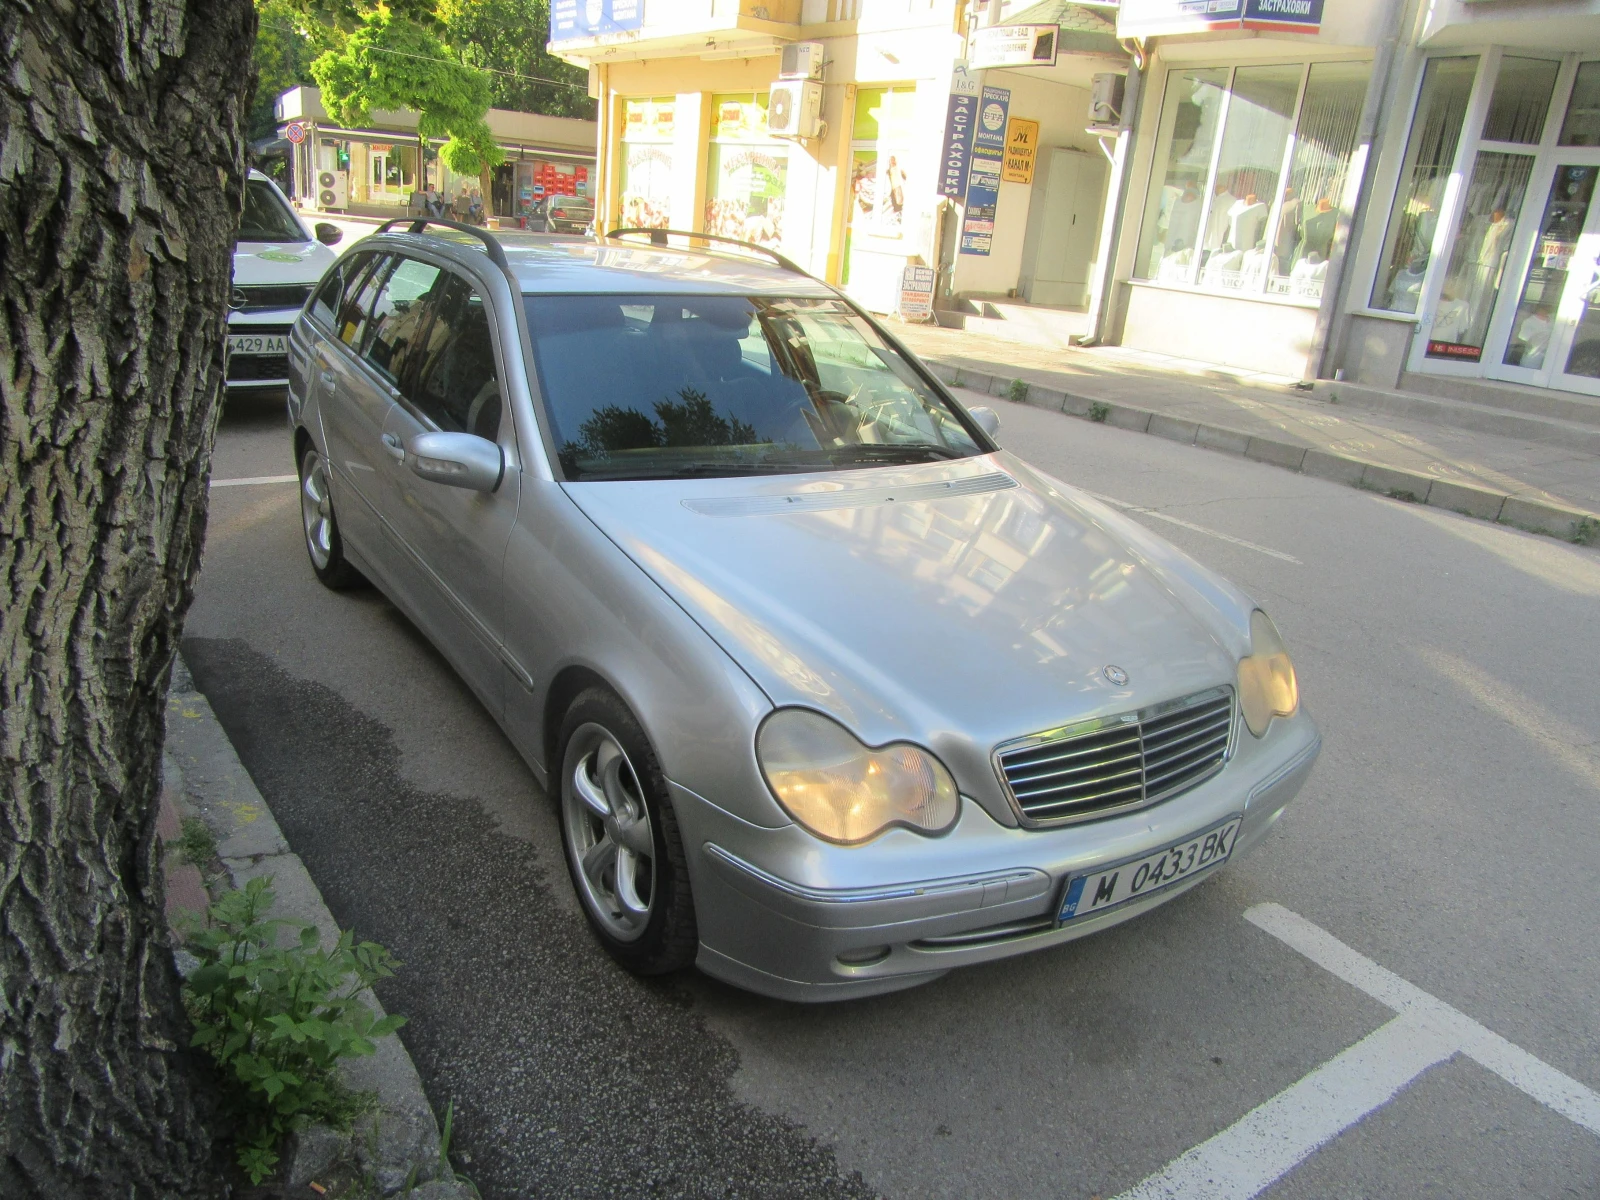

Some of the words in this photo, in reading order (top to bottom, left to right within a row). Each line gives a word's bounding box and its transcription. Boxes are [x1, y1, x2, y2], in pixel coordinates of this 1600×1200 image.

[1258, 0, 1311, 15] ЗАСТРАХОВКИ
[983, 92, 1009, 102] ПРЕСКЛУБ
[978, 132, 1003, 141] МОНТАНА
[944, 97, 969, 195] ЗАСТРАХОВКИ
[1092, 872, 1119, 906] M
[1062, 902, 1077, 914] BG
